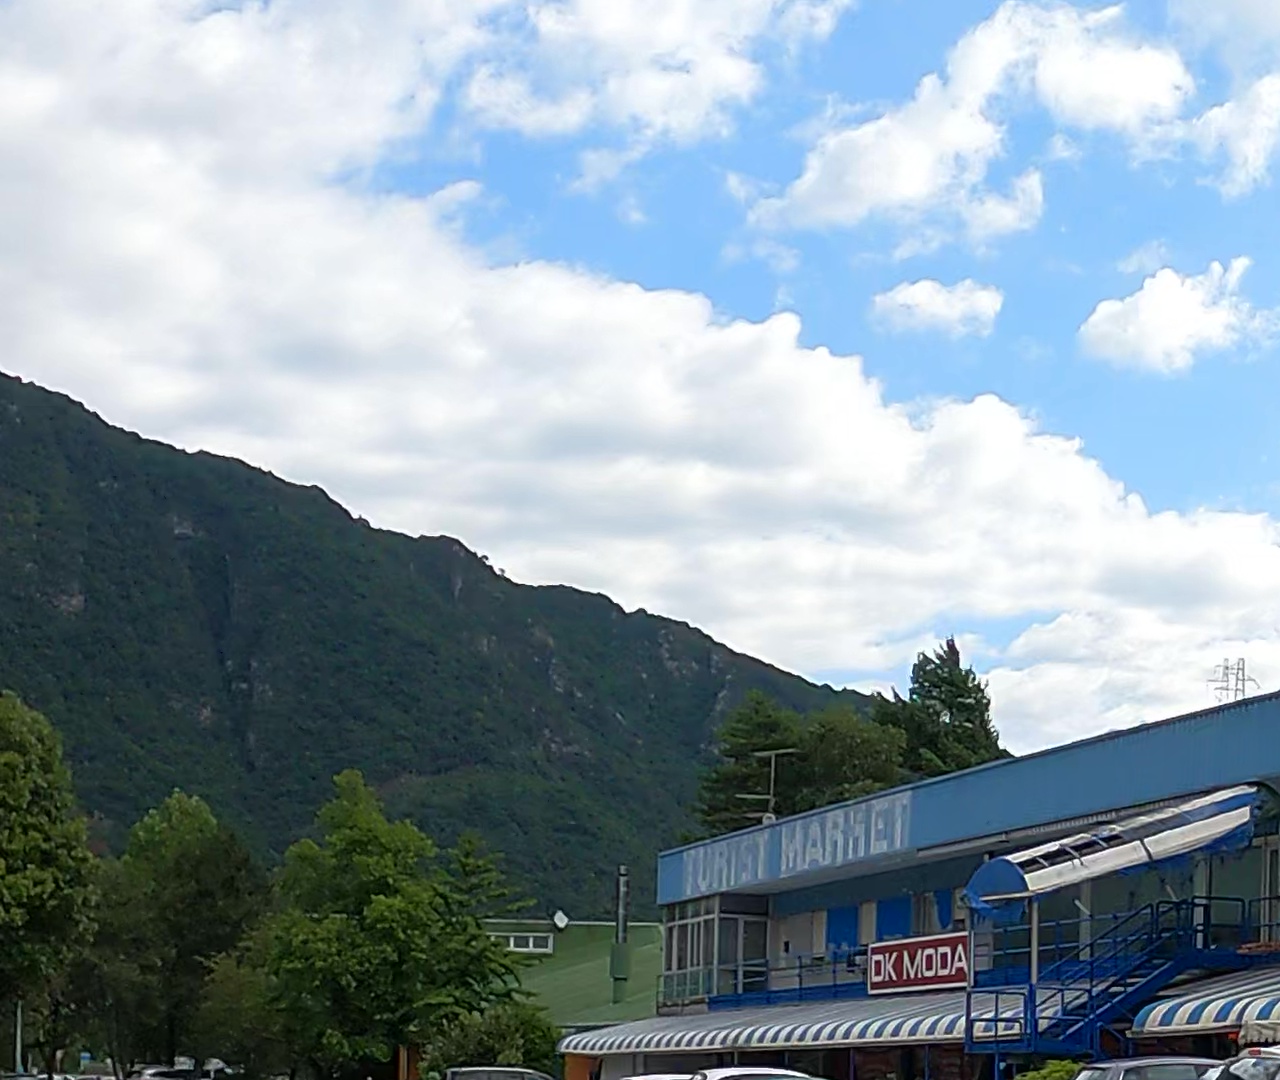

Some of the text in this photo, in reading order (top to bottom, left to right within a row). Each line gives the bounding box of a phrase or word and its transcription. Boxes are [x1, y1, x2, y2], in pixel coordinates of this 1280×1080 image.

[683, 791, 912, 896] TURIST MARKET
[871, 943, 968, 982] DK MODA
